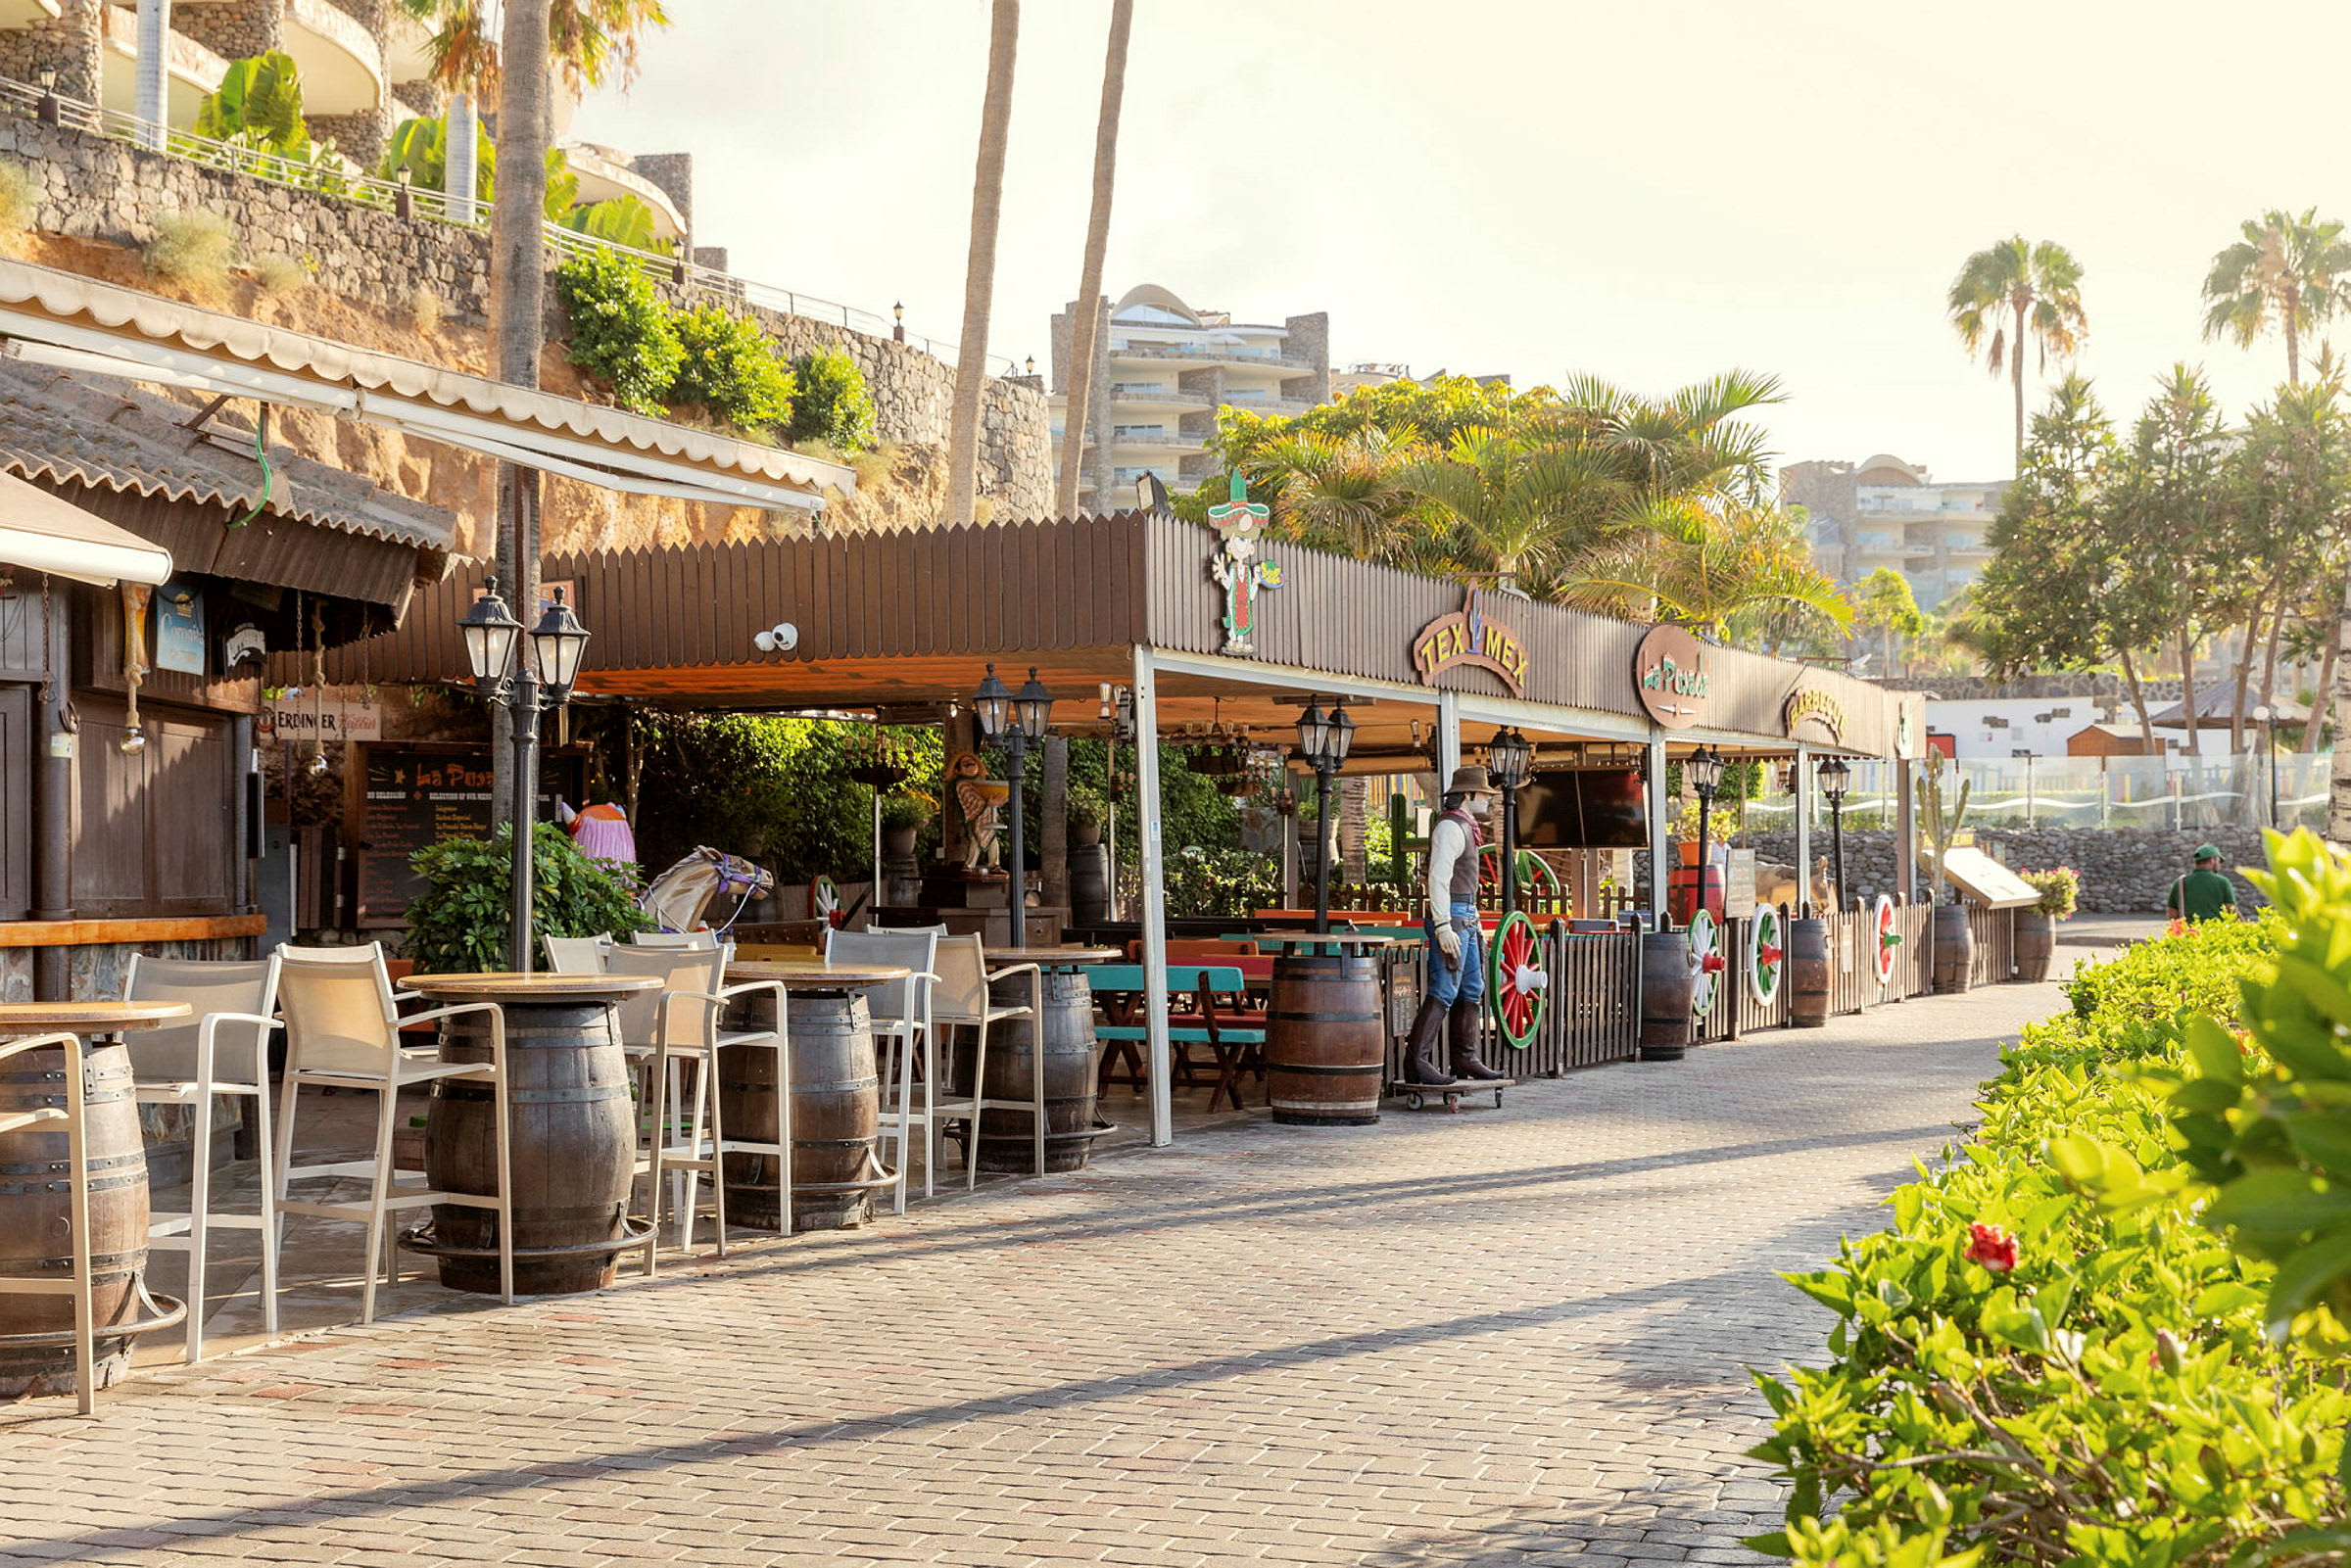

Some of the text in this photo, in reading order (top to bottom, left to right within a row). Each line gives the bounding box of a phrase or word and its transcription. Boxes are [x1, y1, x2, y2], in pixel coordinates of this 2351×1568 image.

[1420, 623, 1528, 689] TEX MEX
[1790, 689, 1848, 739] BARBECUE
